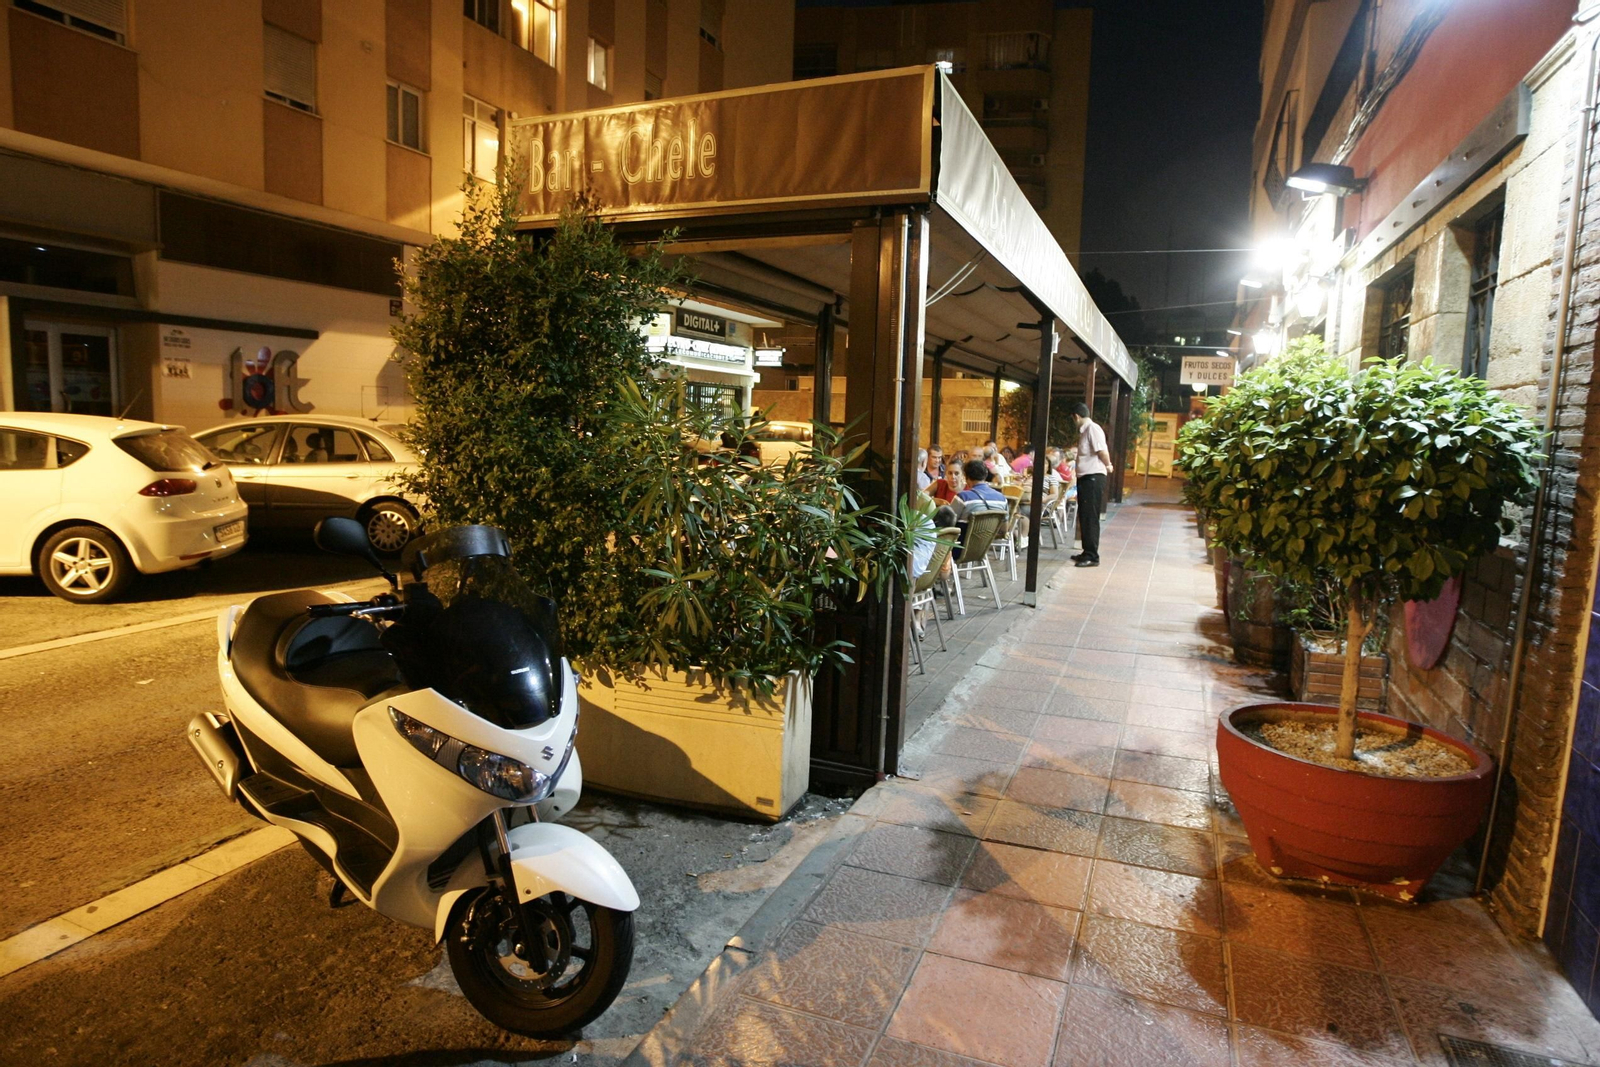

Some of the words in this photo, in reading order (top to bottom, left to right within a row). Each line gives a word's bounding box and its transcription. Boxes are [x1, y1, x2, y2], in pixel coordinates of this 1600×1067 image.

[529, 138, 576, 194] Bar
[619, 118, 717, 185] Chele
[683, 313, 720, 333] DIGITAL+
[1184, 361, 1209, 369] FRUTOS
[1211, 361, 1232, 369] SECOS
[1197, 372, 1228, 380] DULCES
